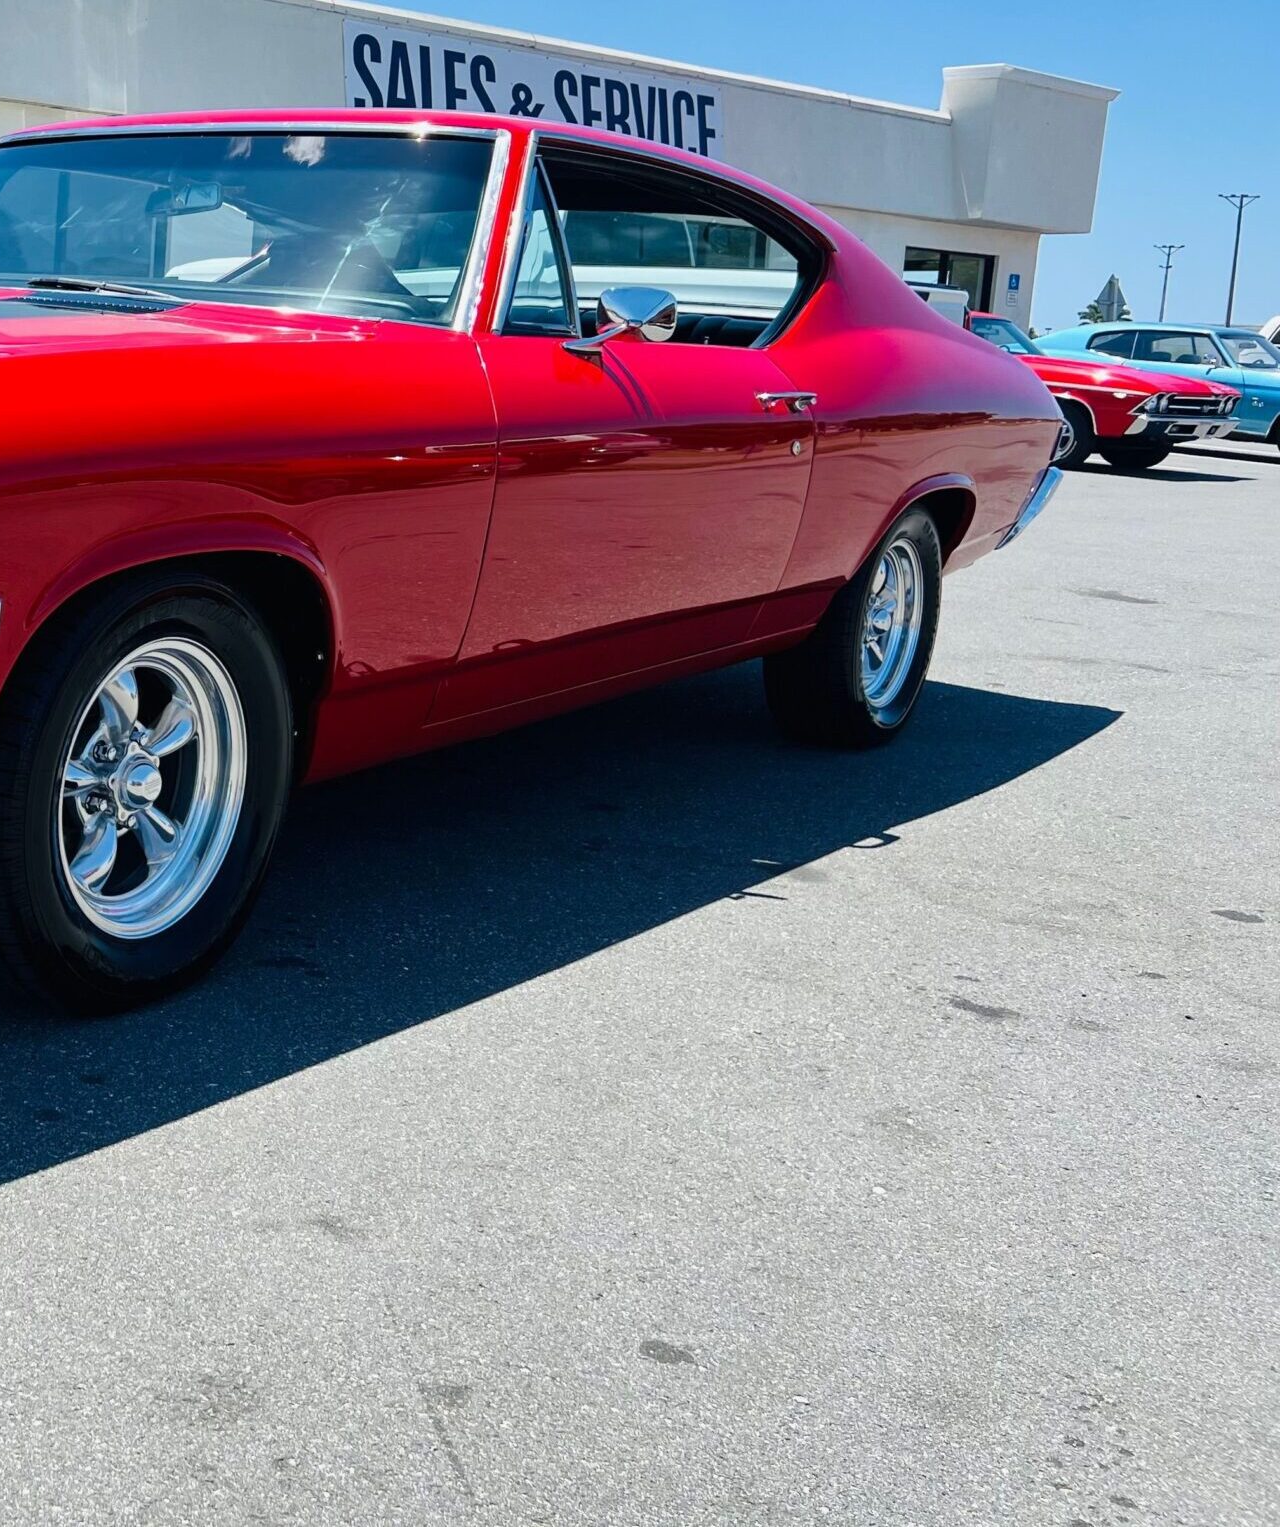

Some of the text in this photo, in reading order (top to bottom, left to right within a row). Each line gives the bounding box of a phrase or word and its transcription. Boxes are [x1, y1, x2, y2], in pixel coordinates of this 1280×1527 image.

[353, 34, 716, 157] SALES & SERVICE
